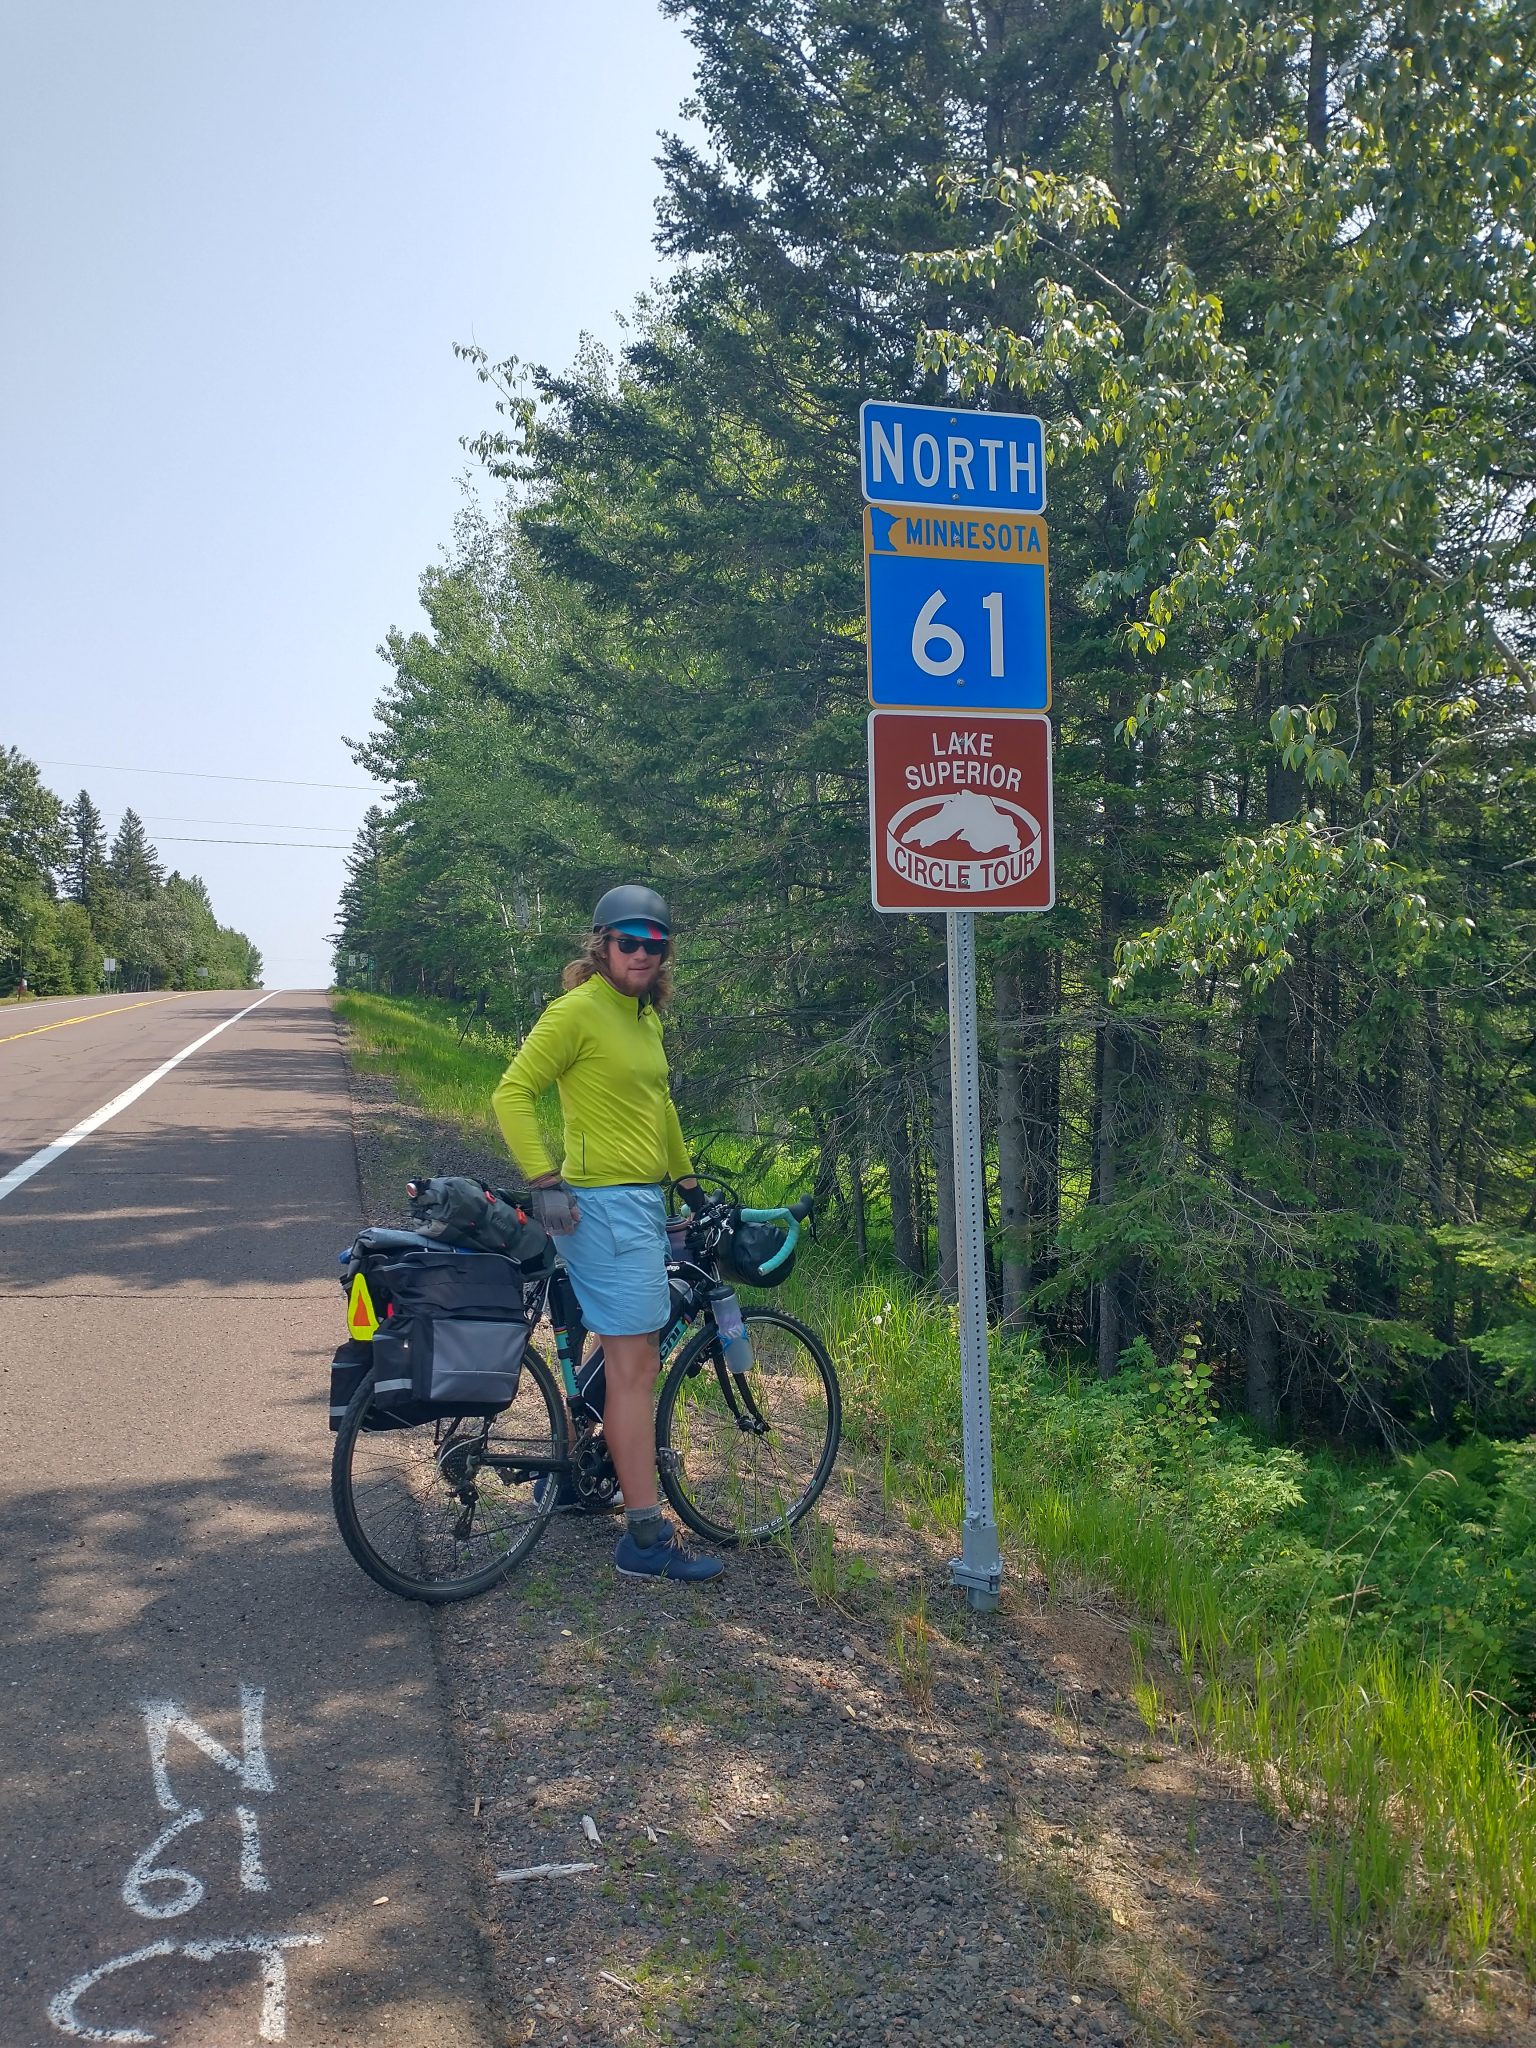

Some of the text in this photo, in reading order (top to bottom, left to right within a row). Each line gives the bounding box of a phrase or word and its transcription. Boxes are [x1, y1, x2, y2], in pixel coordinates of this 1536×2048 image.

[871, 420, 1037, 494] NORTH
[905, 517, 1042, 553] MINNESOTA
[911, 588, 1005, 678] 61
[932, 731, 994, 758] LAKE
[904, 760, 1022, 793] SUPERIOR
[893, 846, 1035, 889] CIRCLE TOUR
[141, 1683, 277, 1812] N
[122, 1804, 273, 1920] 61
